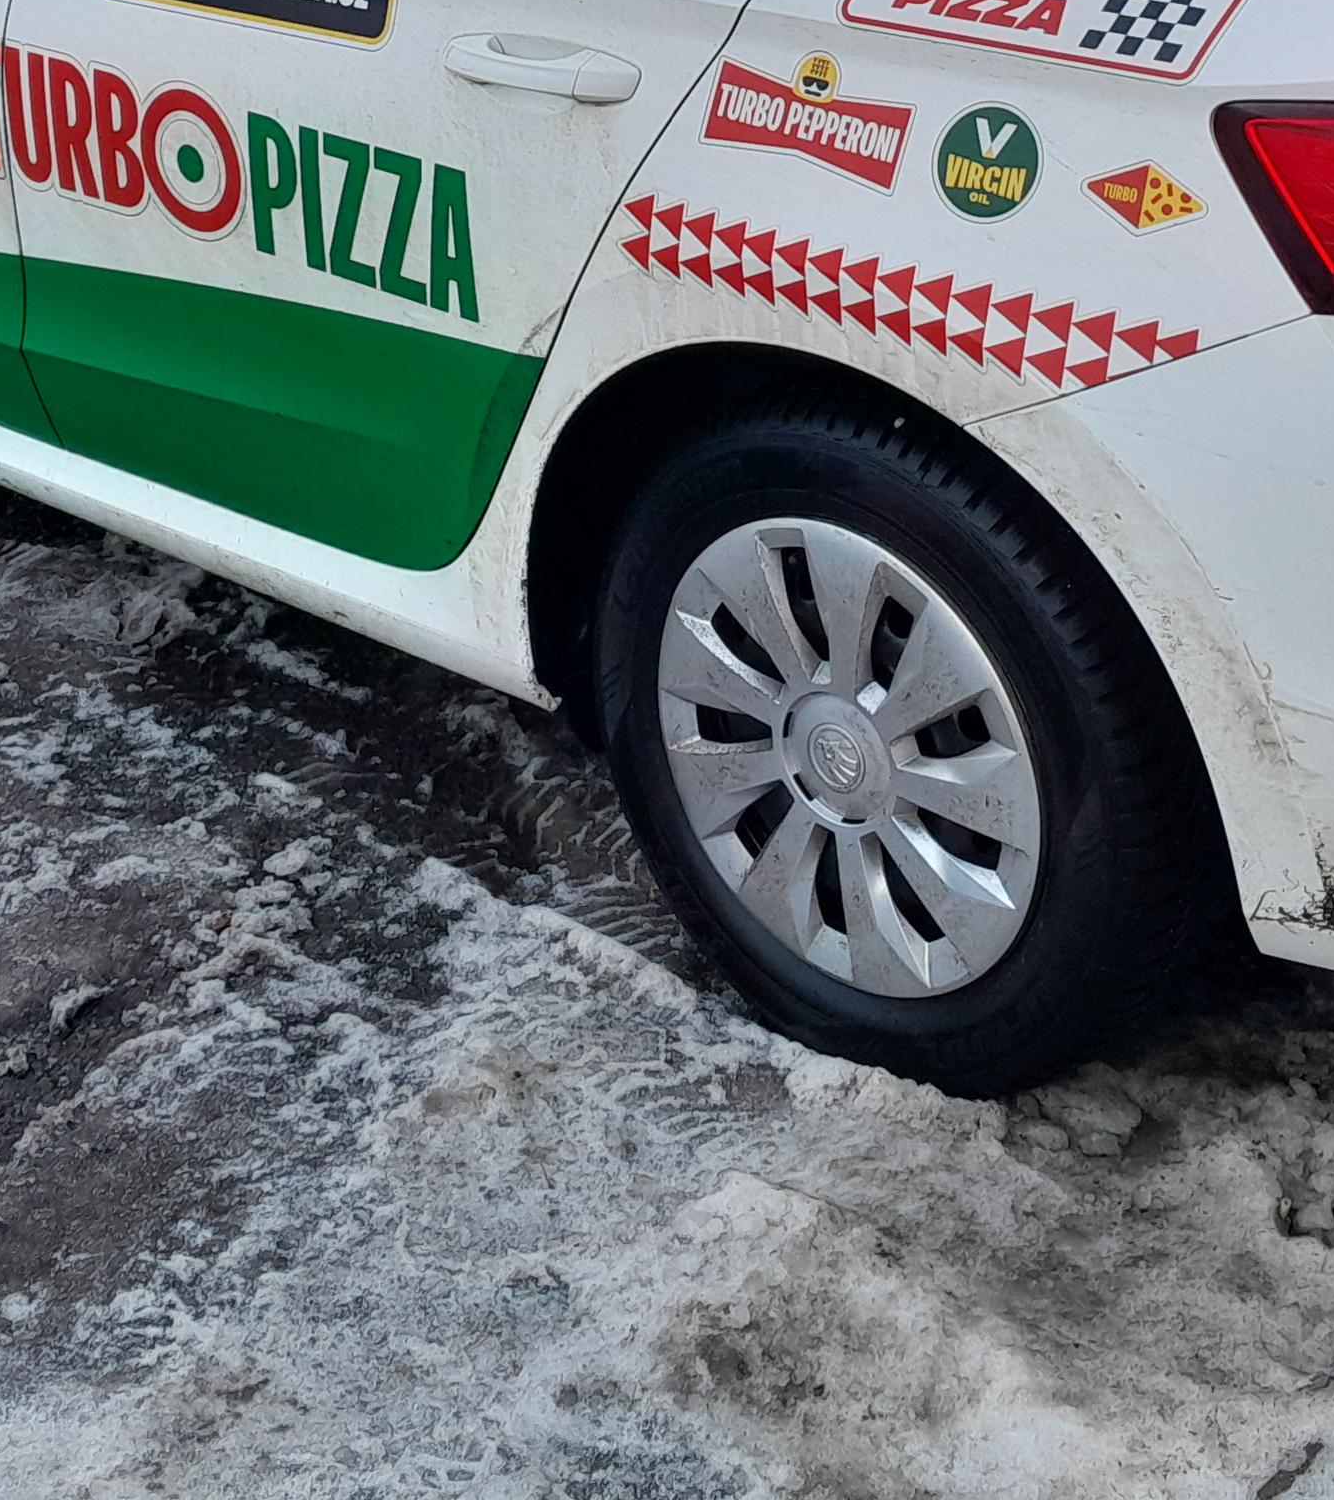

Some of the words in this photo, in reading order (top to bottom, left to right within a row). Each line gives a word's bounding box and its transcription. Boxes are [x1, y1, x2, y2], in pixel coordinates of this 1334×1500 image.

[717, 83, 786, 132] TURBO
[783, 101, 902, 164] PEPPERONI
[975, 116, 1018, 159] V
[944, 152, 1027, 202] VIRGIN
[968, 191, 990, 205] OIL
[1101, 182, 1138, 204] TURBO
[246, 110, 480, 323] PIZZA
